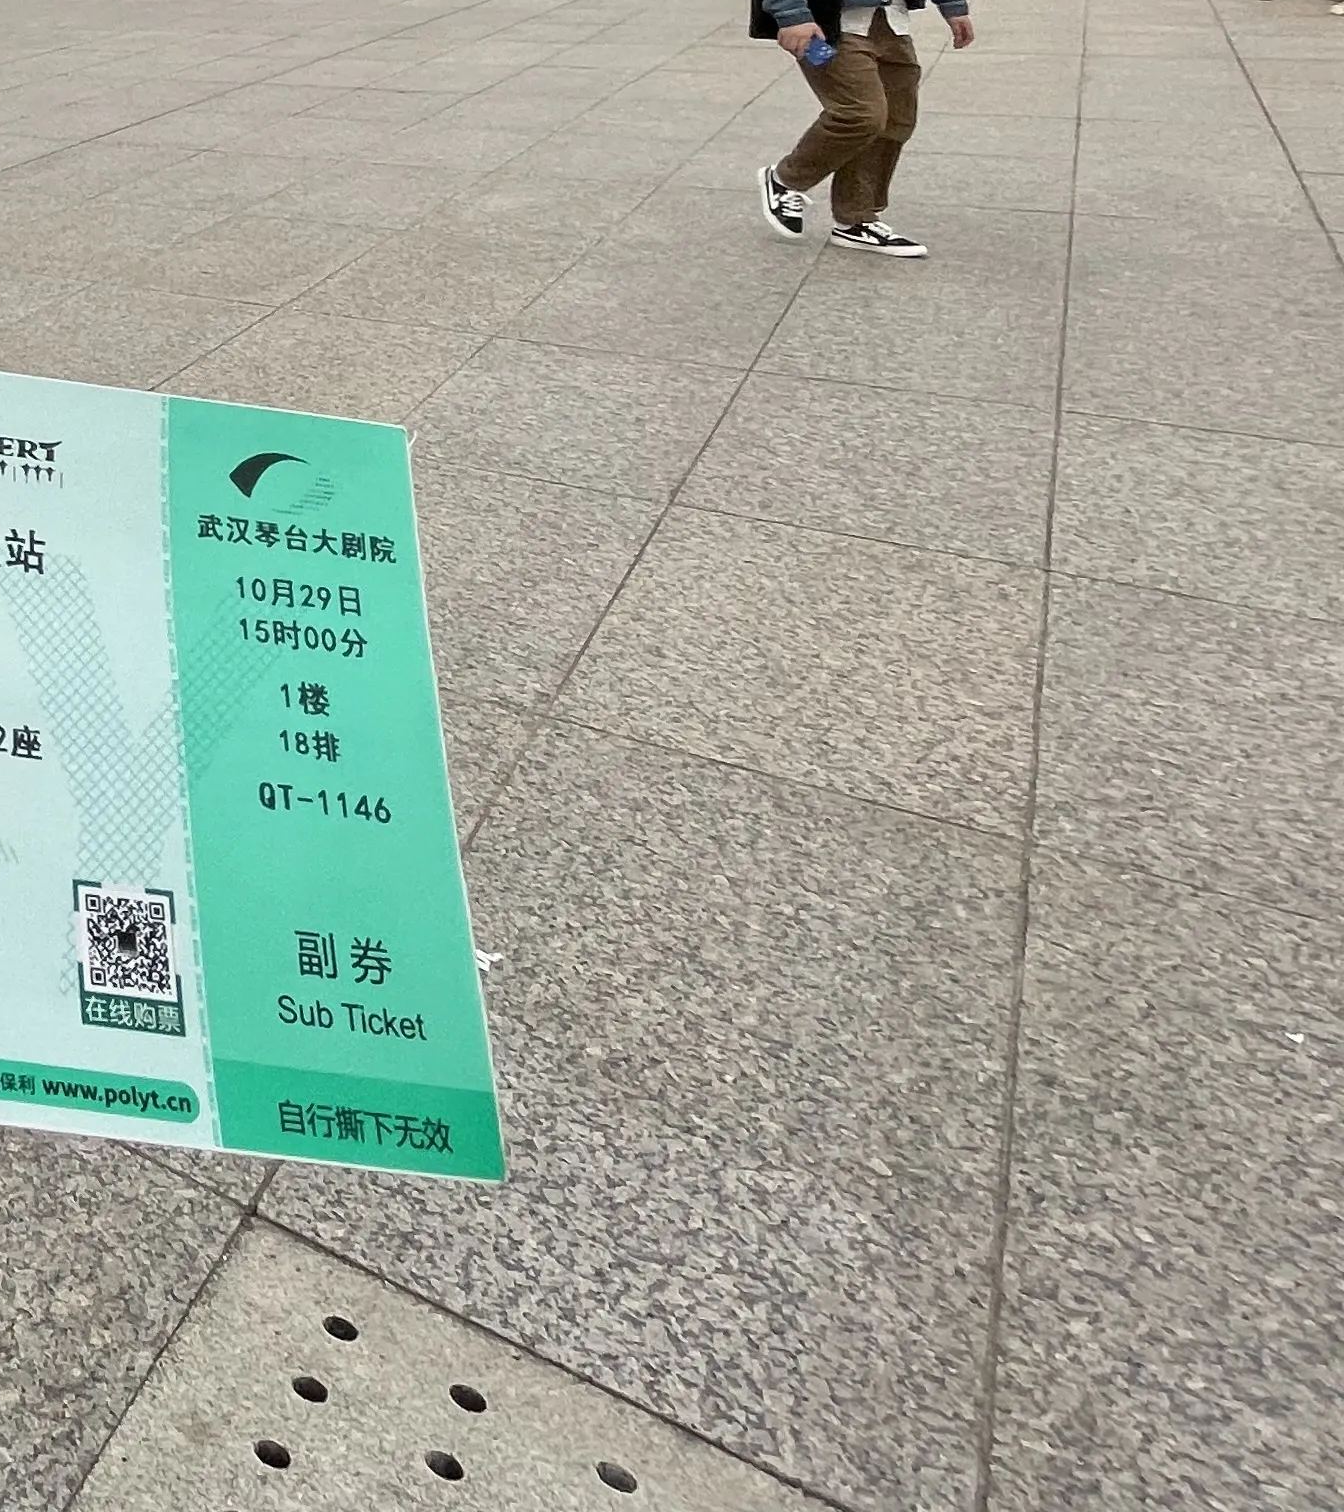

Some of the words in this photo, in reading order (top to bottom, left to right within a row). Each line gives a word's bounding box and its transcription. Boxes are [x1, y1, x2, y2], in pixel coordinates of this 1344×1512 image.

[195, 510, 398, 565] 武汉琴台大剧院
[233, 571, 363, 618] 10月29日
[237, 612, 370, 660] 15时00分
[278, 677, 332, 718] 1楼
[278, 724, 342, 764] 18排
[257, 780, 393, 825] QT-1146
[293, 928, 395, 988] 副券
[84, 995, 182, 1034] 在线购票
[276, 994, 334, 1030] Sub
[339, 1001, 428, 1041] Ticket
[41, 1075, 193, 1119] www.polyt.cn
[276, 1098, 454, 1154] 自行撕下无效
